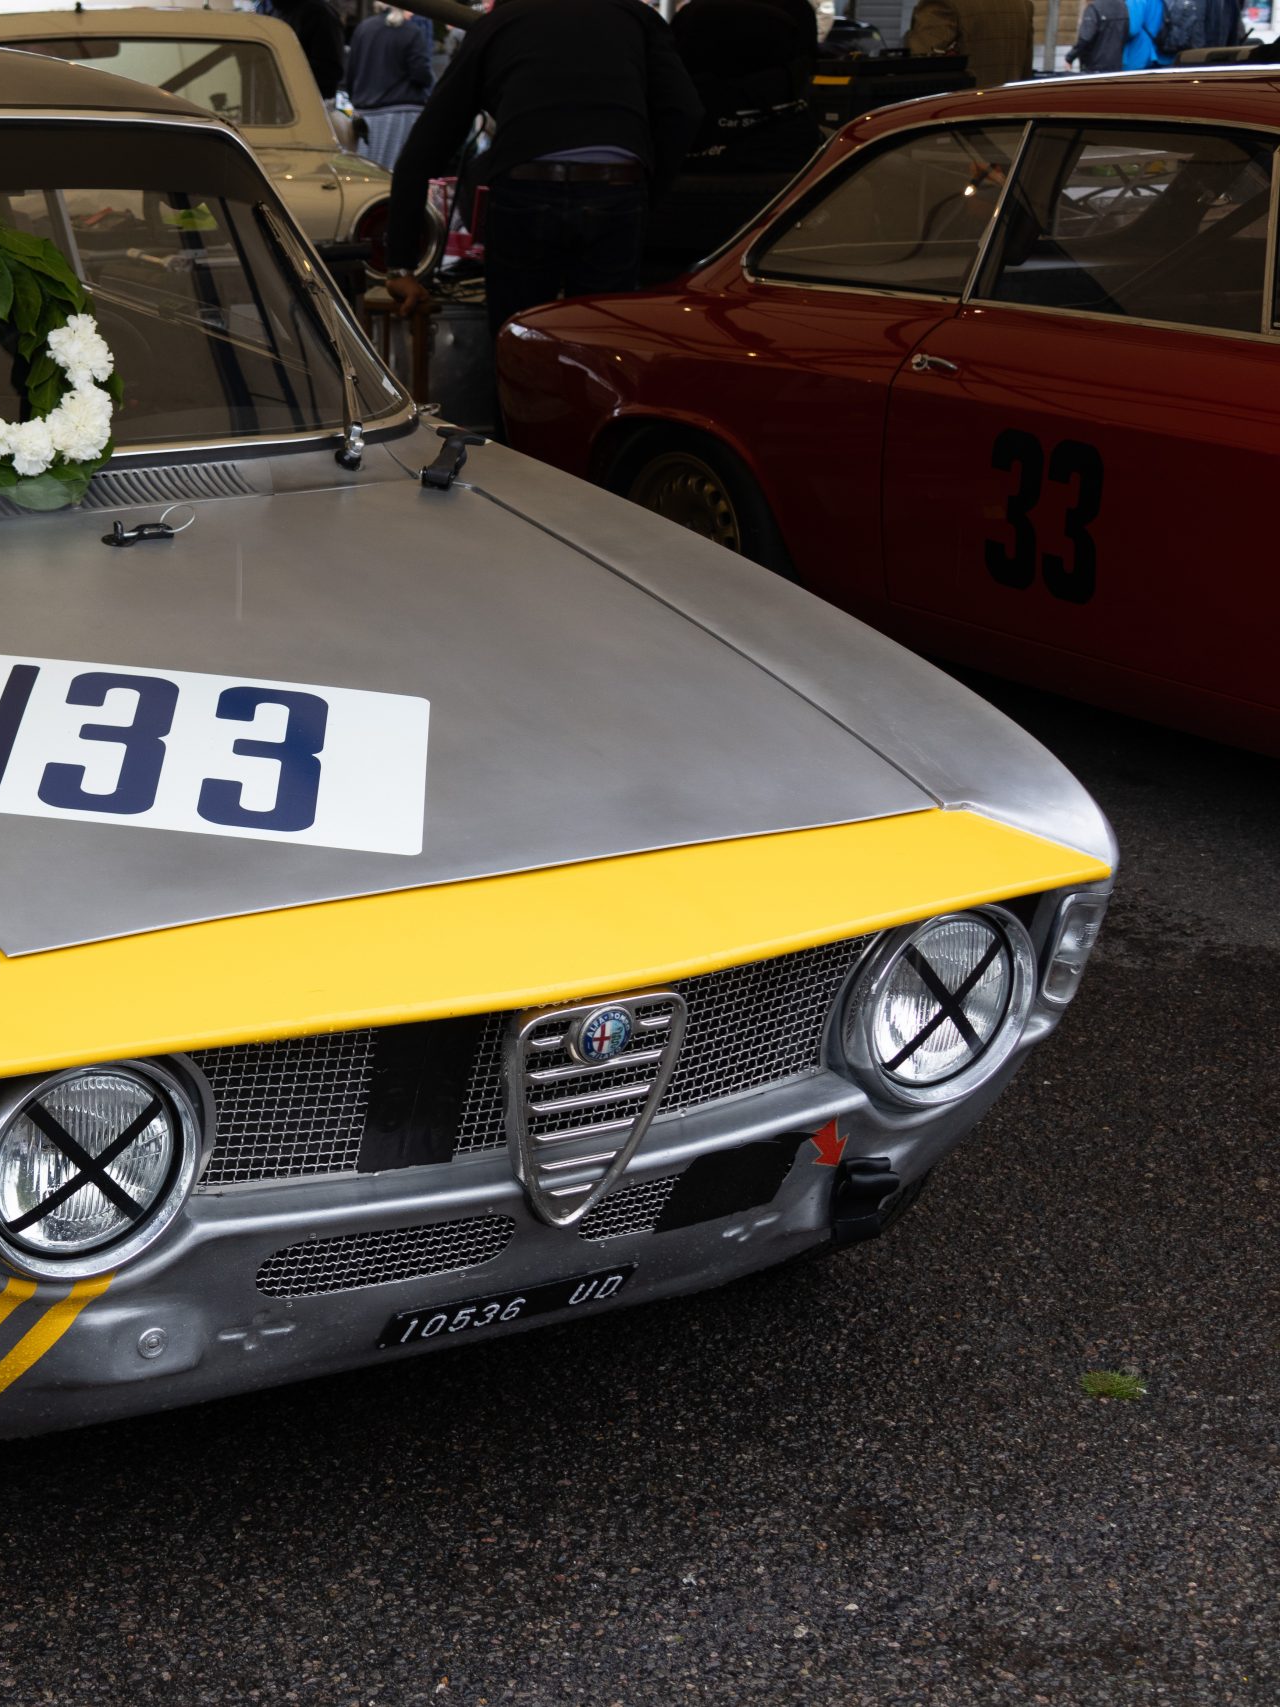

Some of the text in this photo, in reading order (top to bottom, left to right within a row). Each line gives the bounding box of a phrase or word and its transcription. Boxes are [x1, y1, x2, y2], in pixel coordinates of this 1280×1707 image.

[984, 428, 1105, 605] 33
[399, 1275, 623, 1343] 10536 UD
